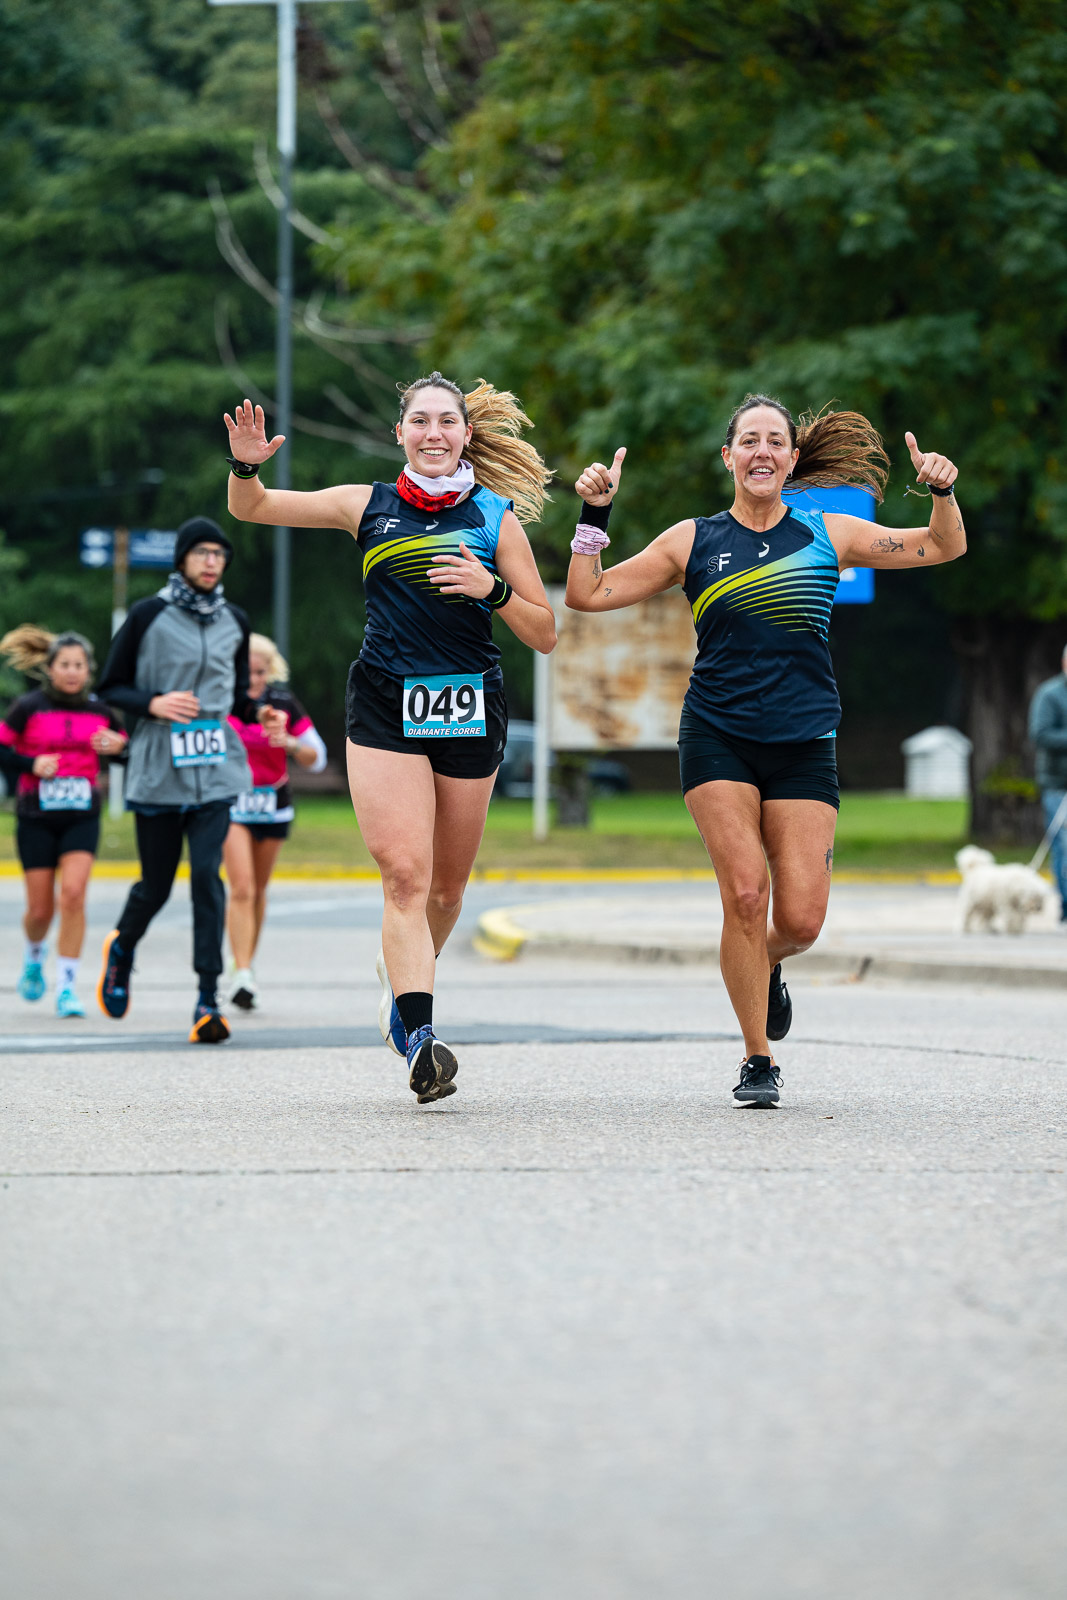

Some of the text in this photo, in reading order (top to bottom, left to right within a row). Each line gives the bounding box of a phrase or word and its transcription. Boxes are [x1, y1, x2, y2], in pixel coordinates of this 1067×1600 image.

[374, 517, 401, 535] SF
[706, 552, 732, 575] SF
[407, 683, 477, 725] 049
[407, 727, 482, 736] DIAMANTE CORRE
